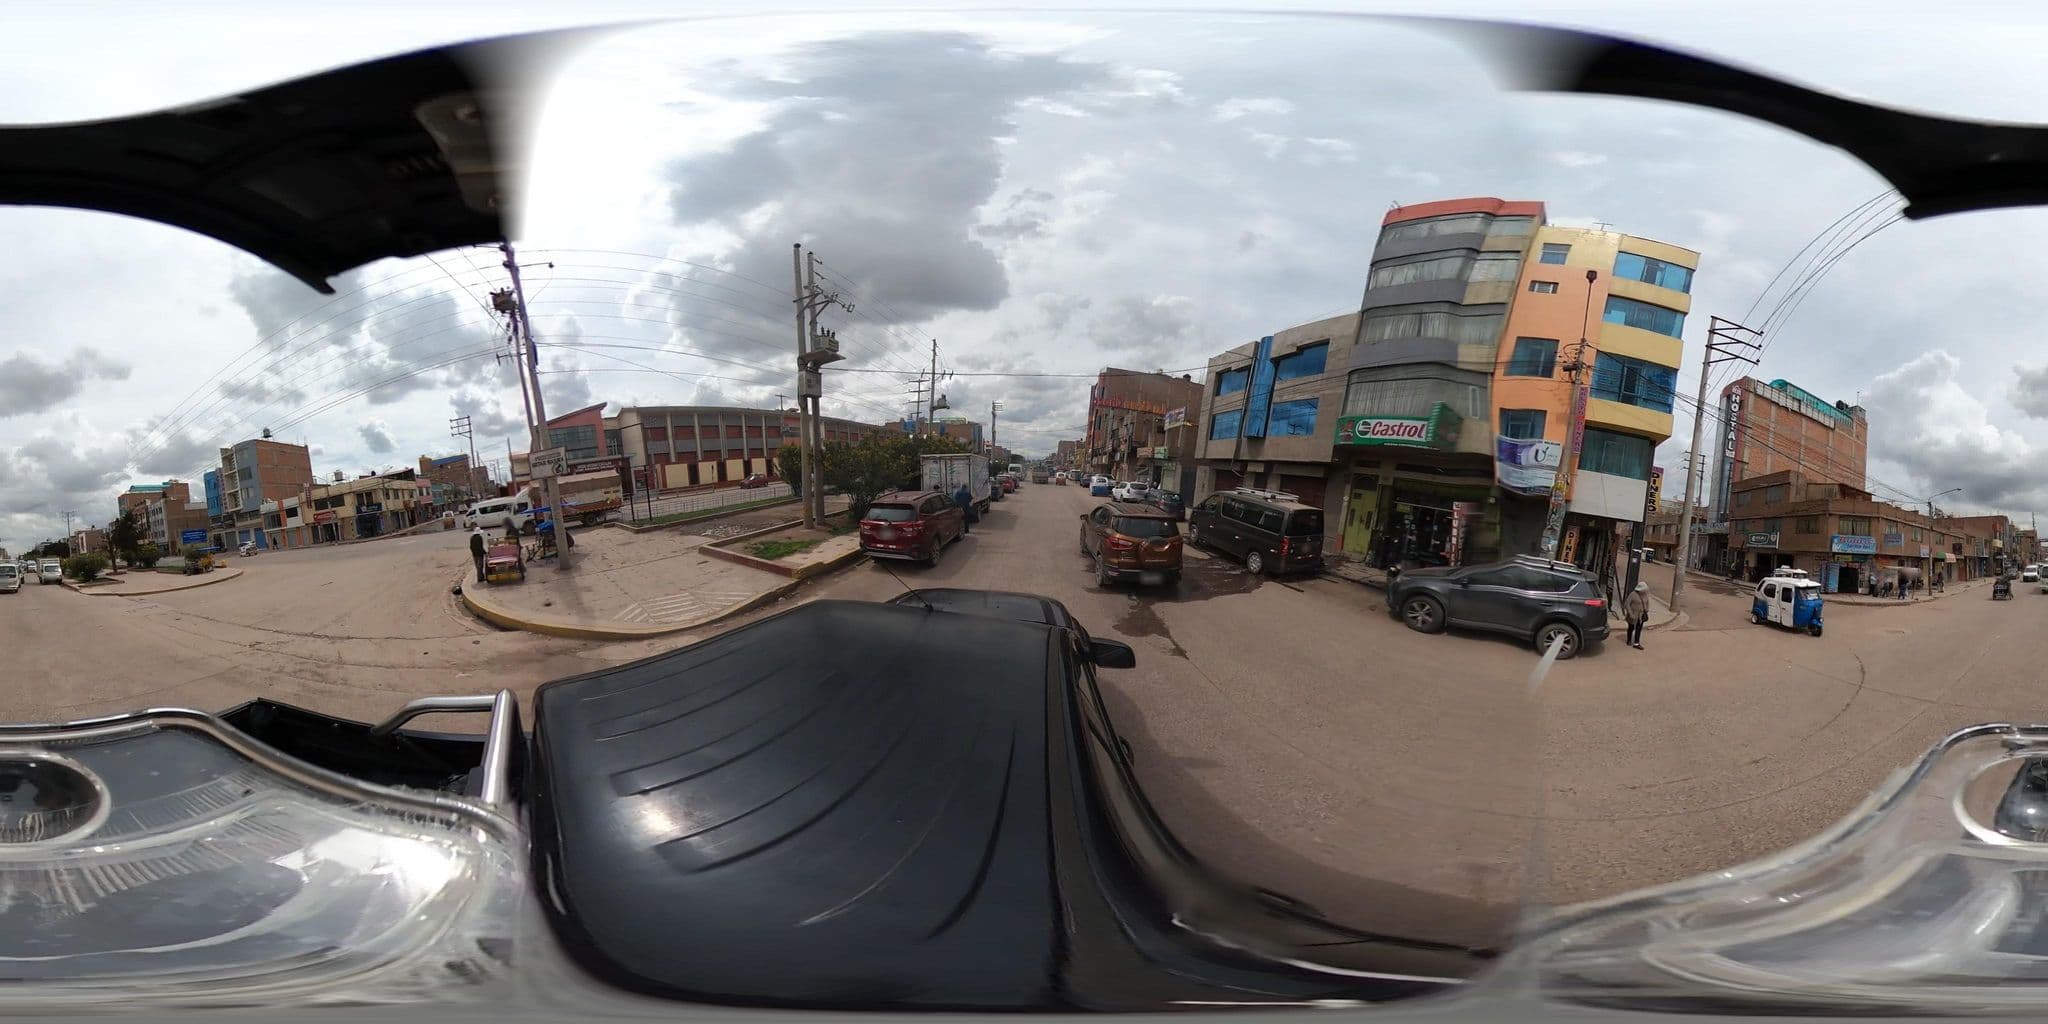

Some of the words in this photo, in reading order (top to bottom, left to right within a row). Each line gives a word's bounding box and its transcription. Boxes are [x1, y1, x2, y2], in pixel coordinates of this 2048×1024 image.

[1371, 421, 1425, 439] Castrol
[1727, 394, 1740, 450] HOSTAL
[1648, 472, 1660, 511] DINERO
